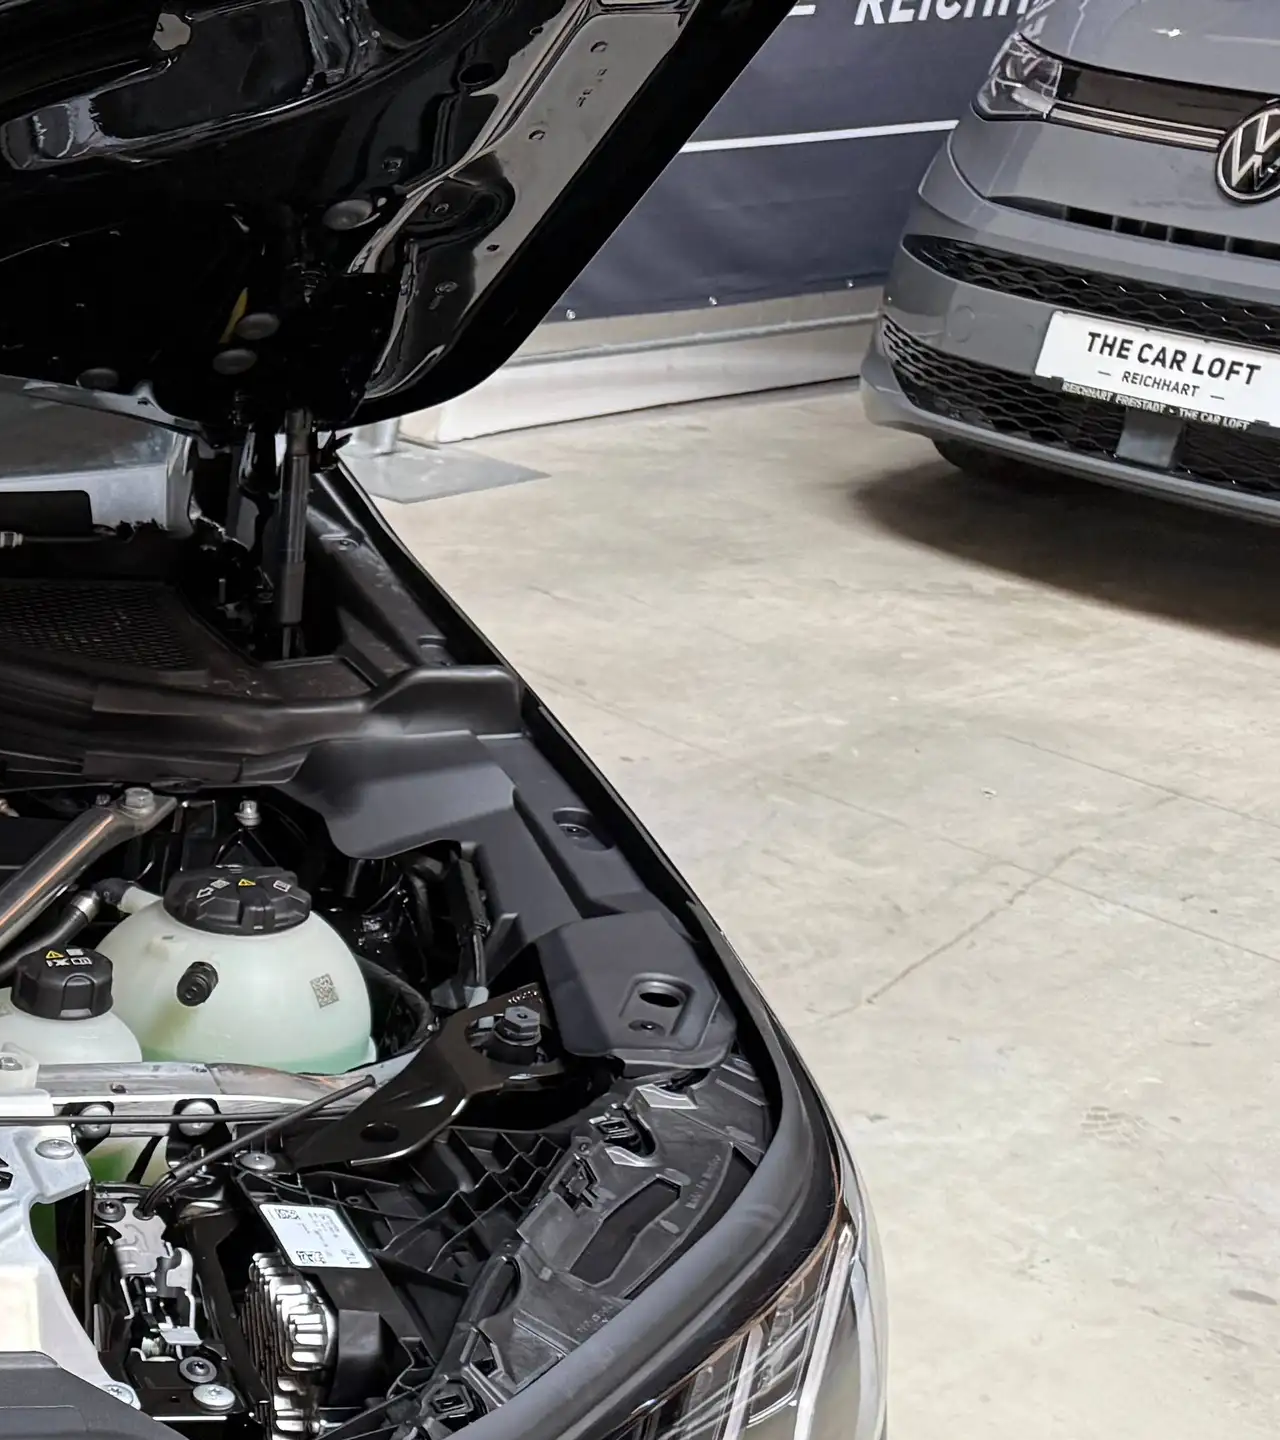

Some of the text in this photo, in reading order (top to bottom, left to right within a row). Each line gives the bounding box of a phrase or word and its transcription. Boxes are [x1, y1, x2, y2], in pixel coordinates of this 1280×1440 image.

[1087, 331, 1261, 386] THE CAR LOFT
[1121, 371, 1200, 398] REICHHART
[1200, 412, 1222, 427] CAR
[1222, 416, 1250, 431] LOFT
